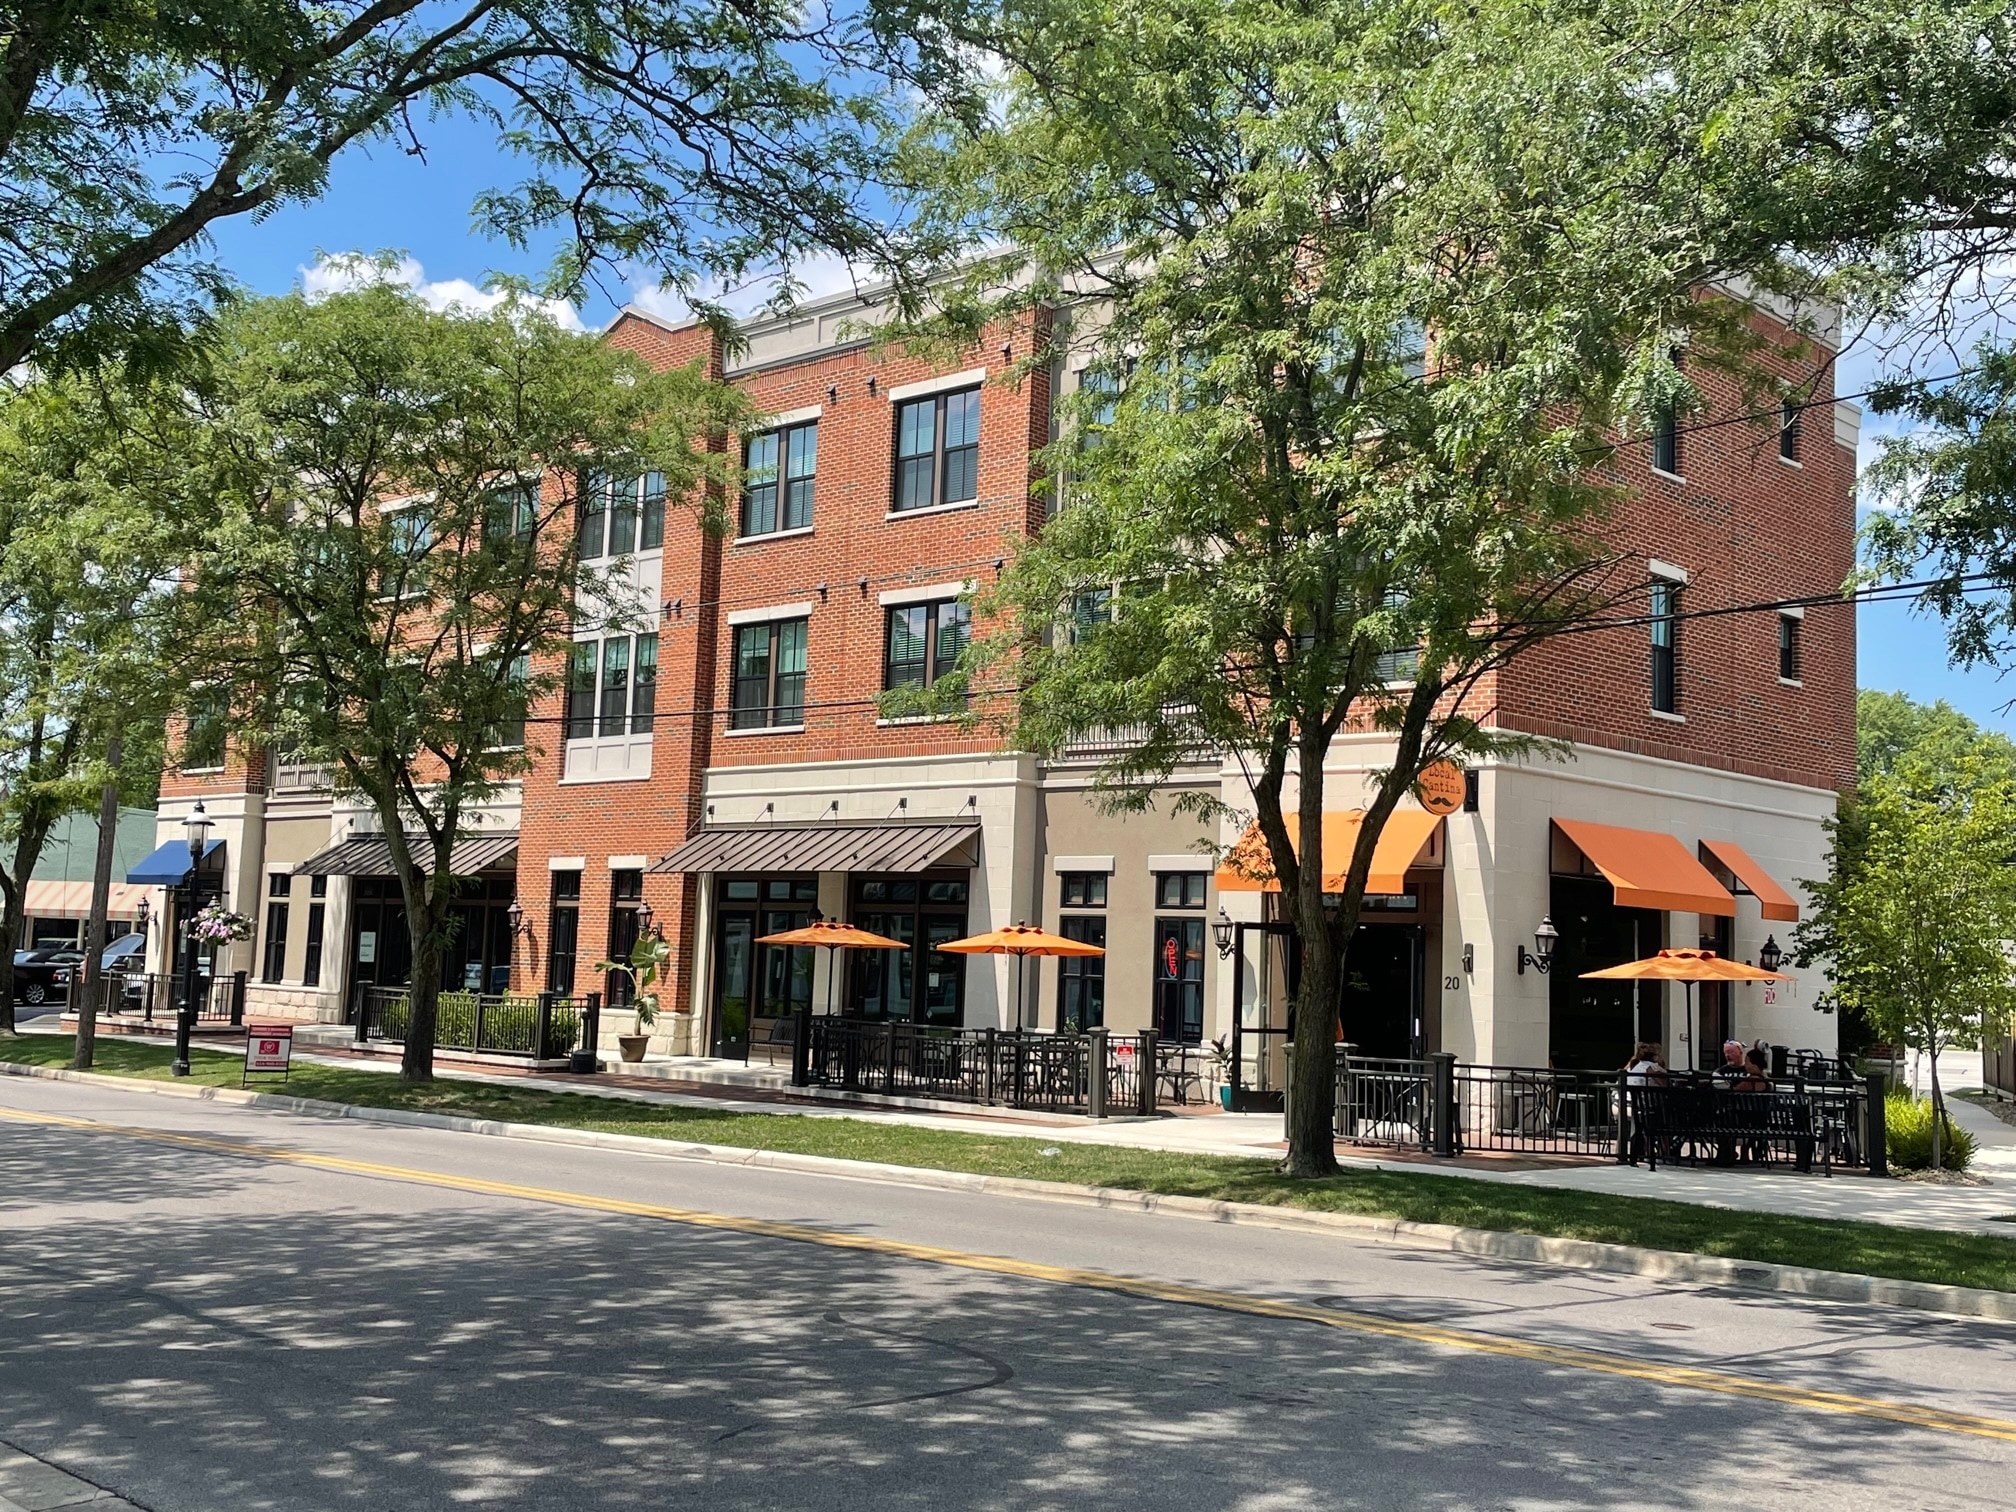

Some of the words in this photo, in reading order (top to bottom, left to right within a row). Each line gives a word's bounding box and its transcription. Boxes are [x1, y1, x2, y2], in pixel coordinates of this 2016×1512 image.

[1428, 766, 1456, 780] Local
[1166, 939, 1178, 976] OPEN
[1444, 976, 1460, 990] 20
